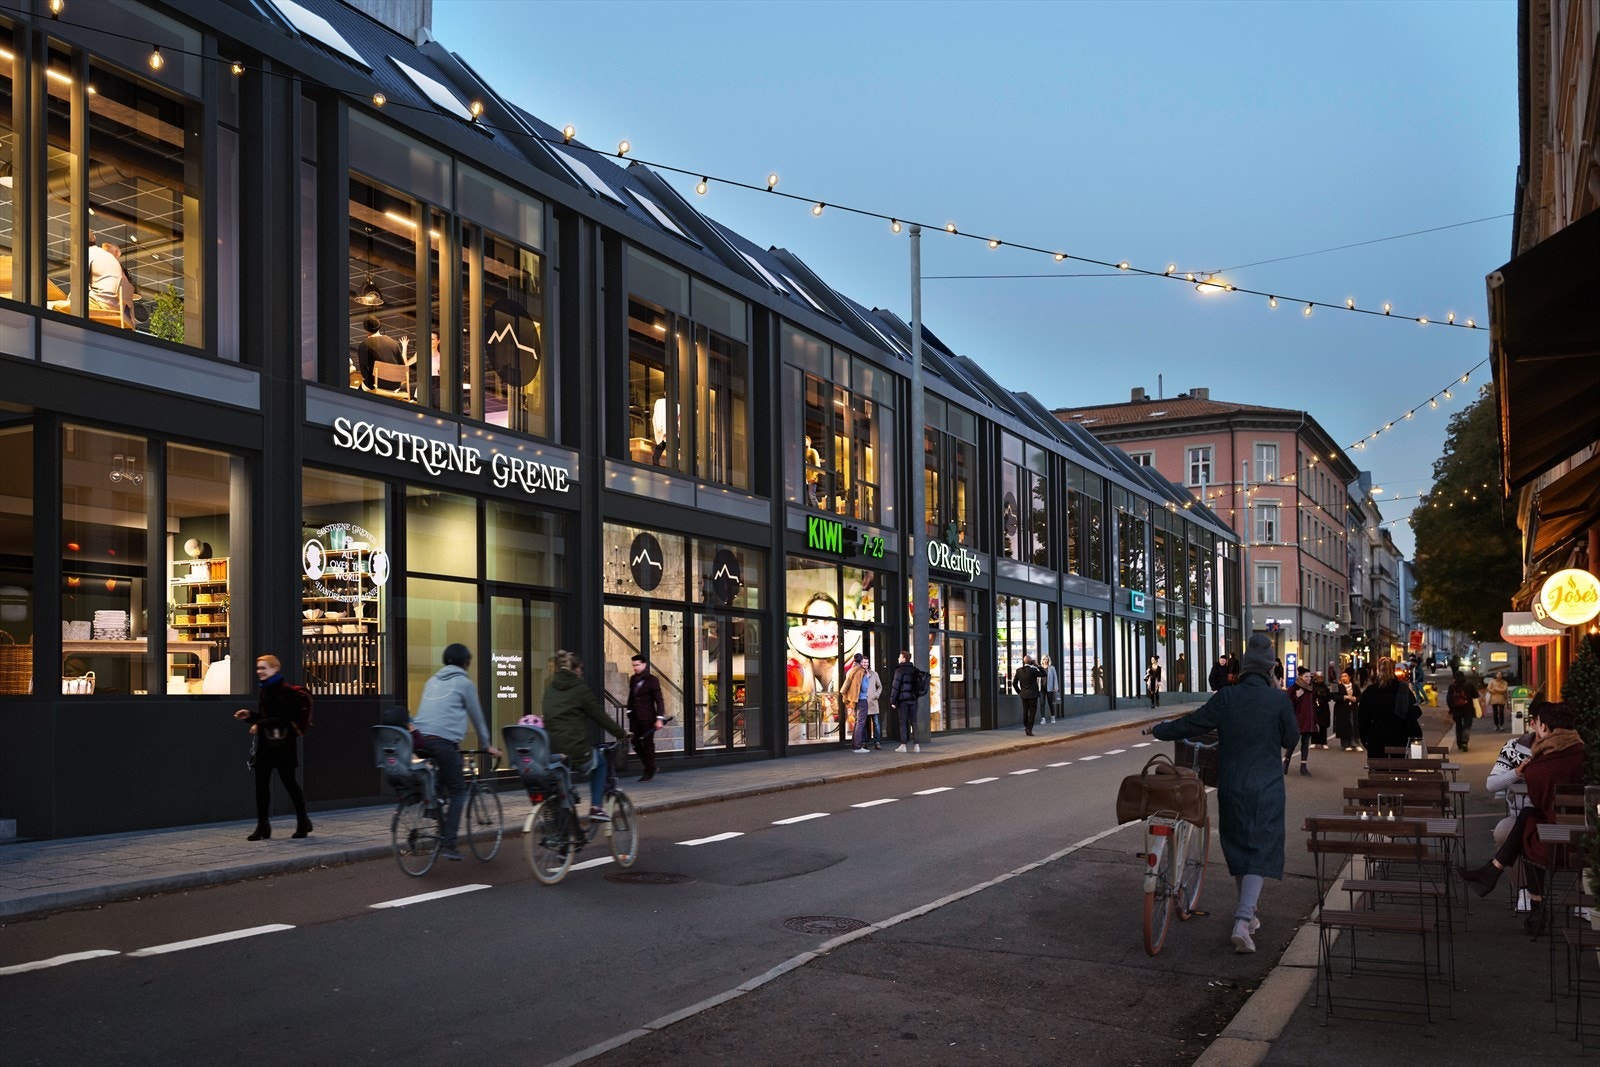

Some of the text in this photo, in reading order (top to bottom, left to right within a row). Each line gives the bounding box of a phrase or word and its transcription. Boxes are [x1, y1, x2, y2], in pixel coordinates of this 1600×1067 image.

[333, 417, 570, 493] SØSTRENE GRENE
[808, 516, 843, 554] KIWI
[863, 534, 885, 558] 7-23
[928, 540, 980, 582] O'Reilly's
